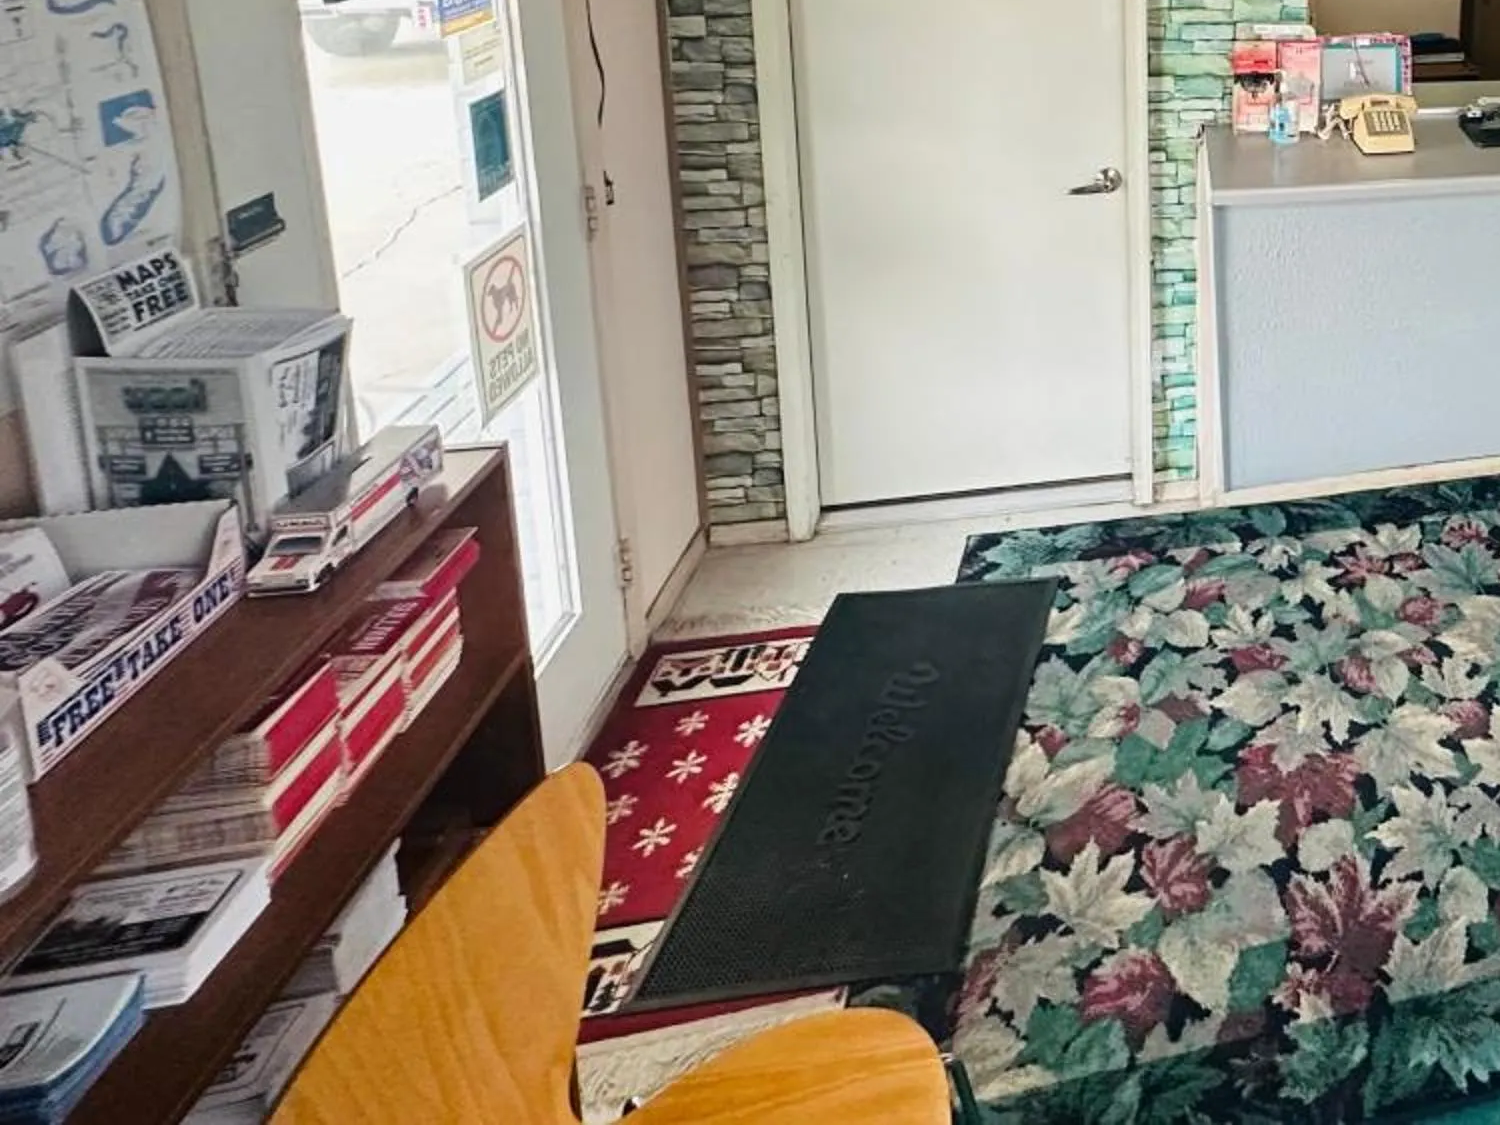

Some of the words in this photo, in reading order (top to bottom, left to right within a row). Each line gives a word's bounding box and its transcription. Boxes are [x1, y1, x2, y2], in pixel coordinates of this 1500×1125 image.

[115, 252, 178, 292] MAPS
[132, 281, 189, 323] FREE
[51, 676, 117, 749] FREE
[126, 616, 183, 681] TAKE
[193, 573, 231, 624] ONE
